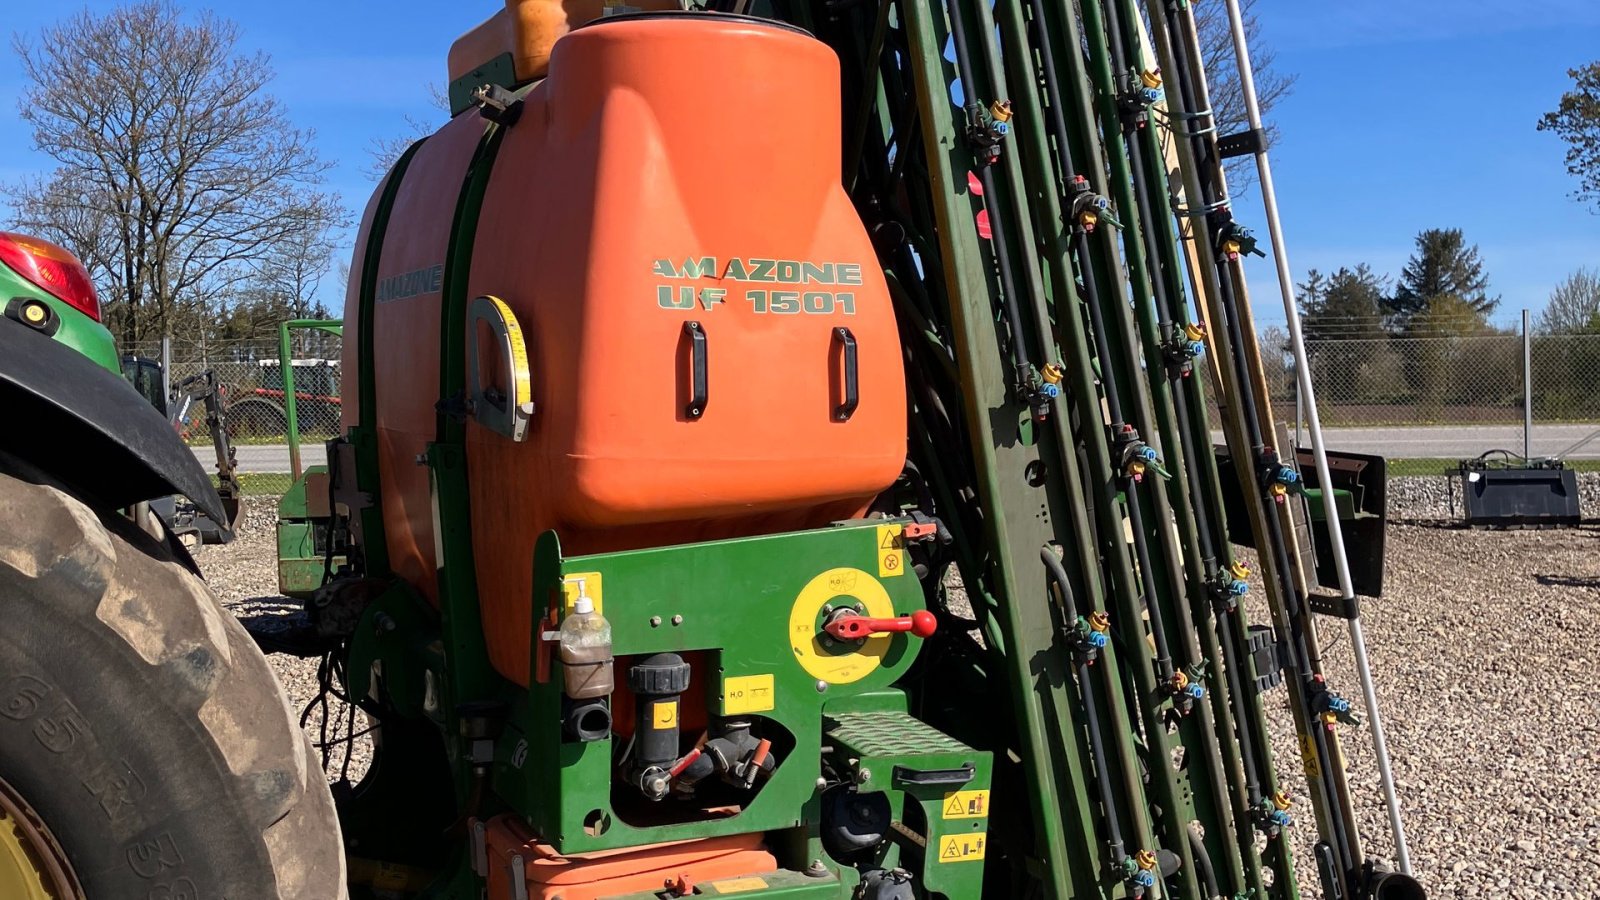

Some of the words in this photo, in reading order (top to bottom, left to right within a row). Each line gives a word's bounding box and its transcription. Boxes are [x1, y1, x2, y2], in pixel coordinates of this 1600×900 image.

[376, 263, 443, 305] AMAZONE
[653, 257, 863, 286] AMAZONE
[657, 285, 727, 312] UF
[746, 290, 856, 315] 1501
